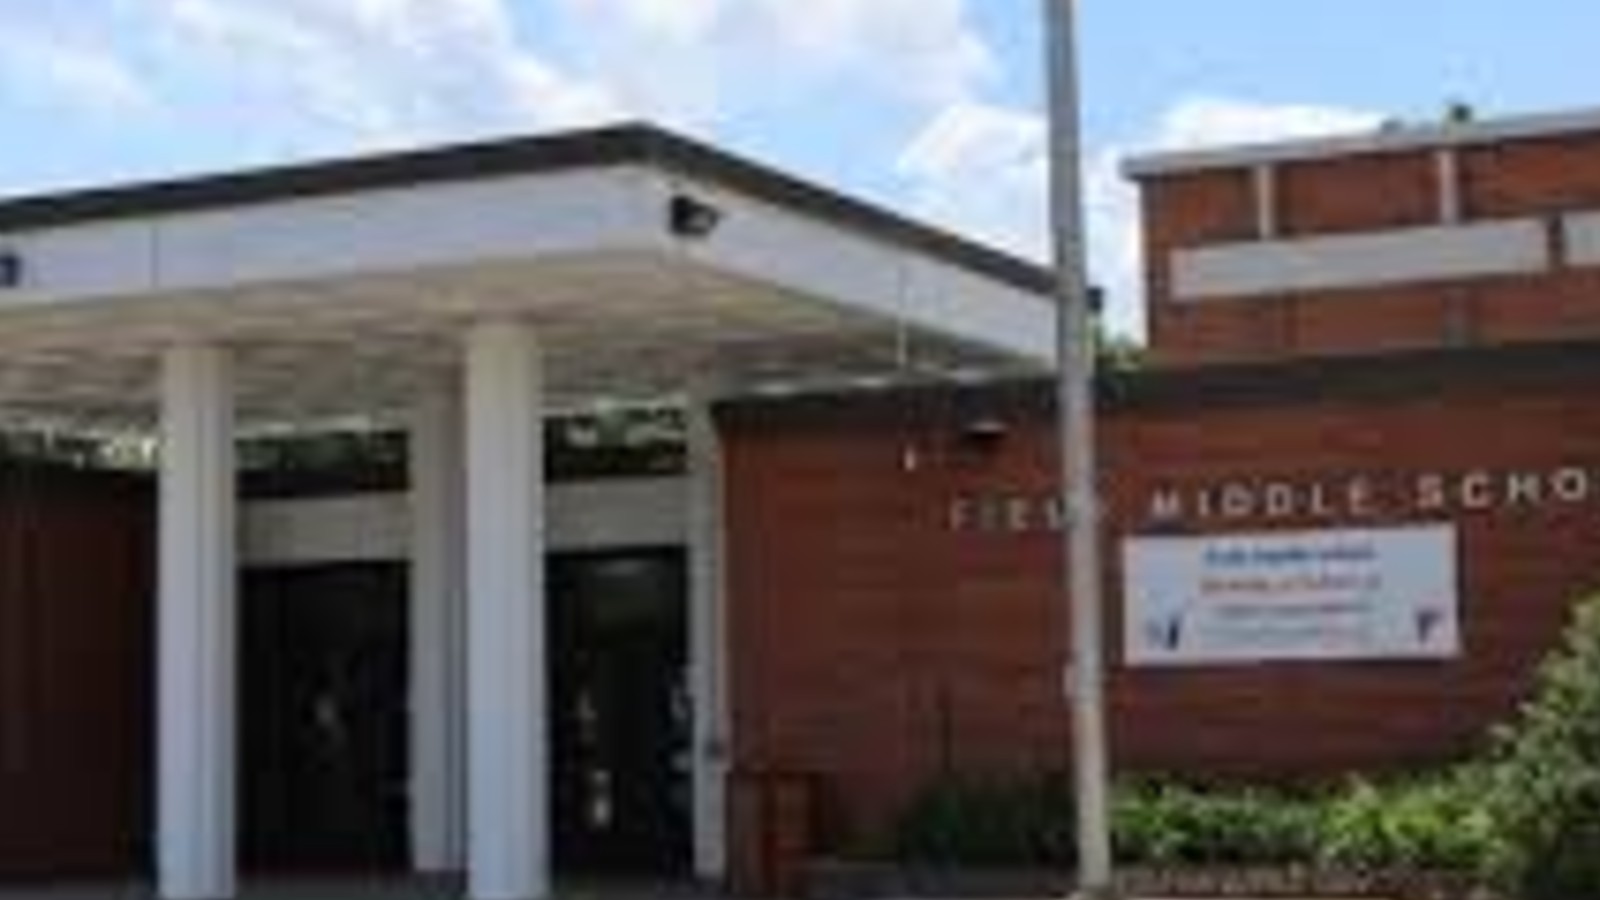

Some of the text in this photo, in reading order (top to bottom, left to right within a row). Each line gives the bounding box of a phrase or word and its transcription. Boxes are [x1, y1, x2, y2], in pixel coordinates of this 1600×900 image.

[949, 468, 1588, 532] FIEL MIDDLE SCHO
